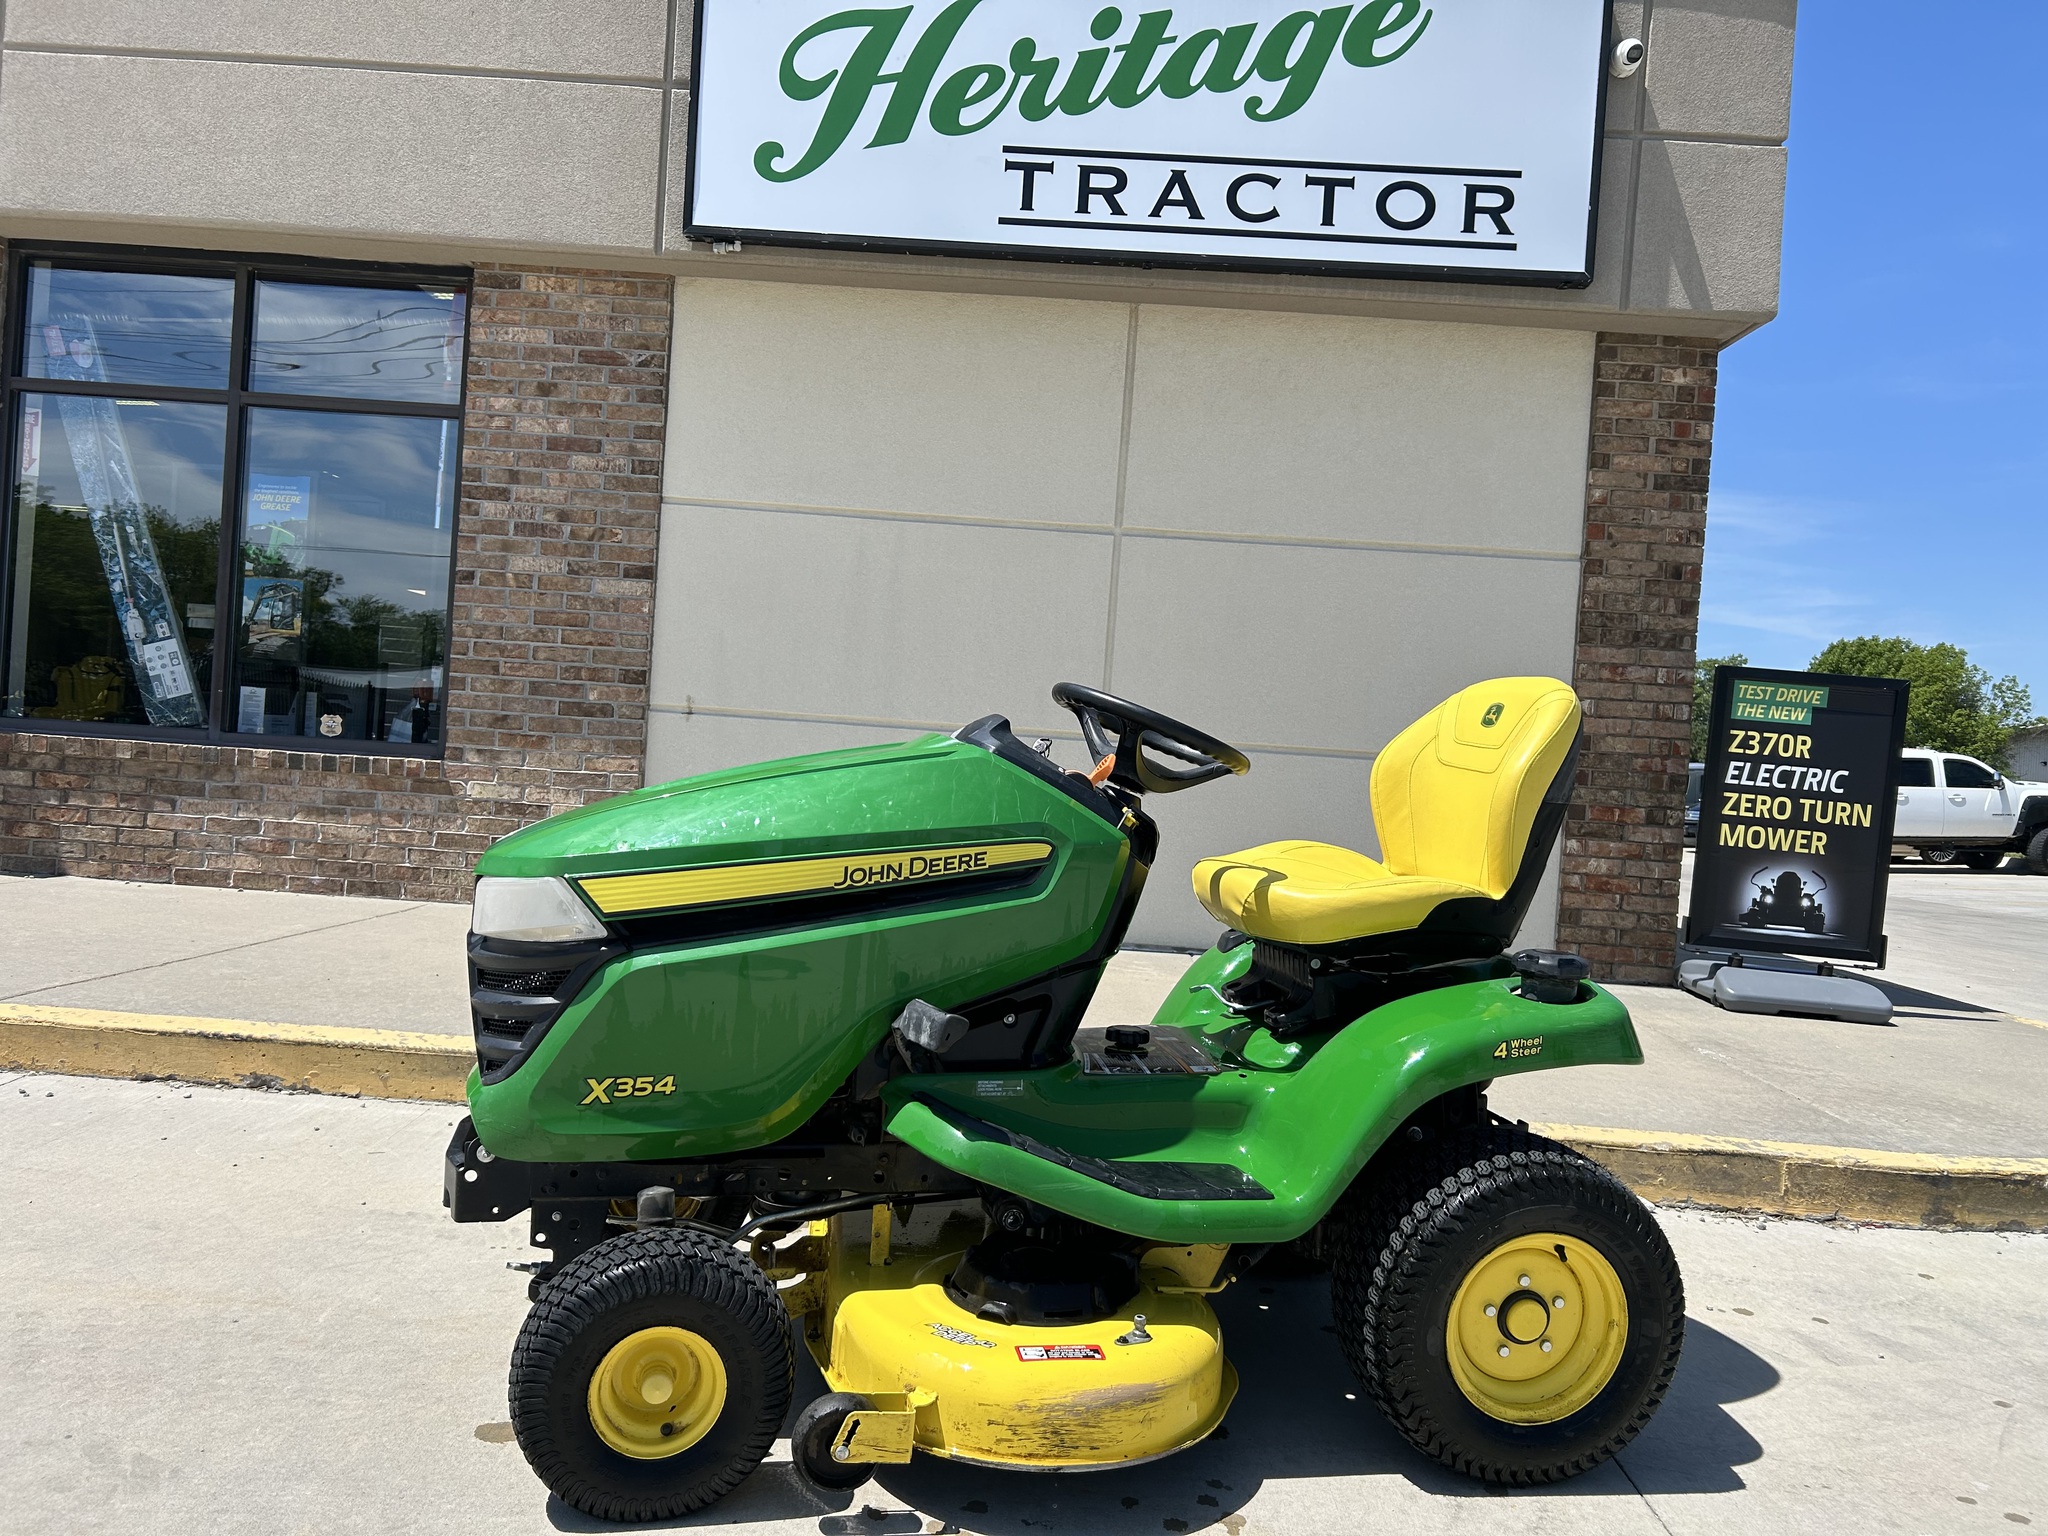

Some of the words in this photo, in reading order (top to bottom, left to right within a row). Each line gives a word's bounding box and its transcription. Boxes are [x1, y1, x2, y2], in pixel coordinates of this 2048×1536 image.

[754, 0, 1431, 182] Heritage
[1004, 159, 1516, 236] TRACTOR
[252, 494, 274, 502] JOHN
[275, 495, 302, 504] DEERE
[260, 502, 292, 511] GREASE
[1738, 684, 1774, 700] TEST
[1776, 687, 1824, 705] DRIVE
[1736, 702, 1767, 718] THE
[1768, 705, 1808, 721] NEW
[1728, 729, 1812, 759] Z370R
[1724, 760, 1850, 794] ELECTRIC
[1721, 791, 1792, 820] ZERO
[1799, 798, 1873, 828] TURN
[1719, 822, 1828, 855] MOWER
[833, 862, 903, 889] JOHN
[909, 851, 988, 878] DEERE
[1493, 1042, 1508, 1059] 4
[1510, 1035, 1543, 1048] Wheel
[1510, 1046, 1542, 1058] Steer
[579, 1075, 677, 1105] X354
[701, 1313, 753, 1409] CARLISLE
